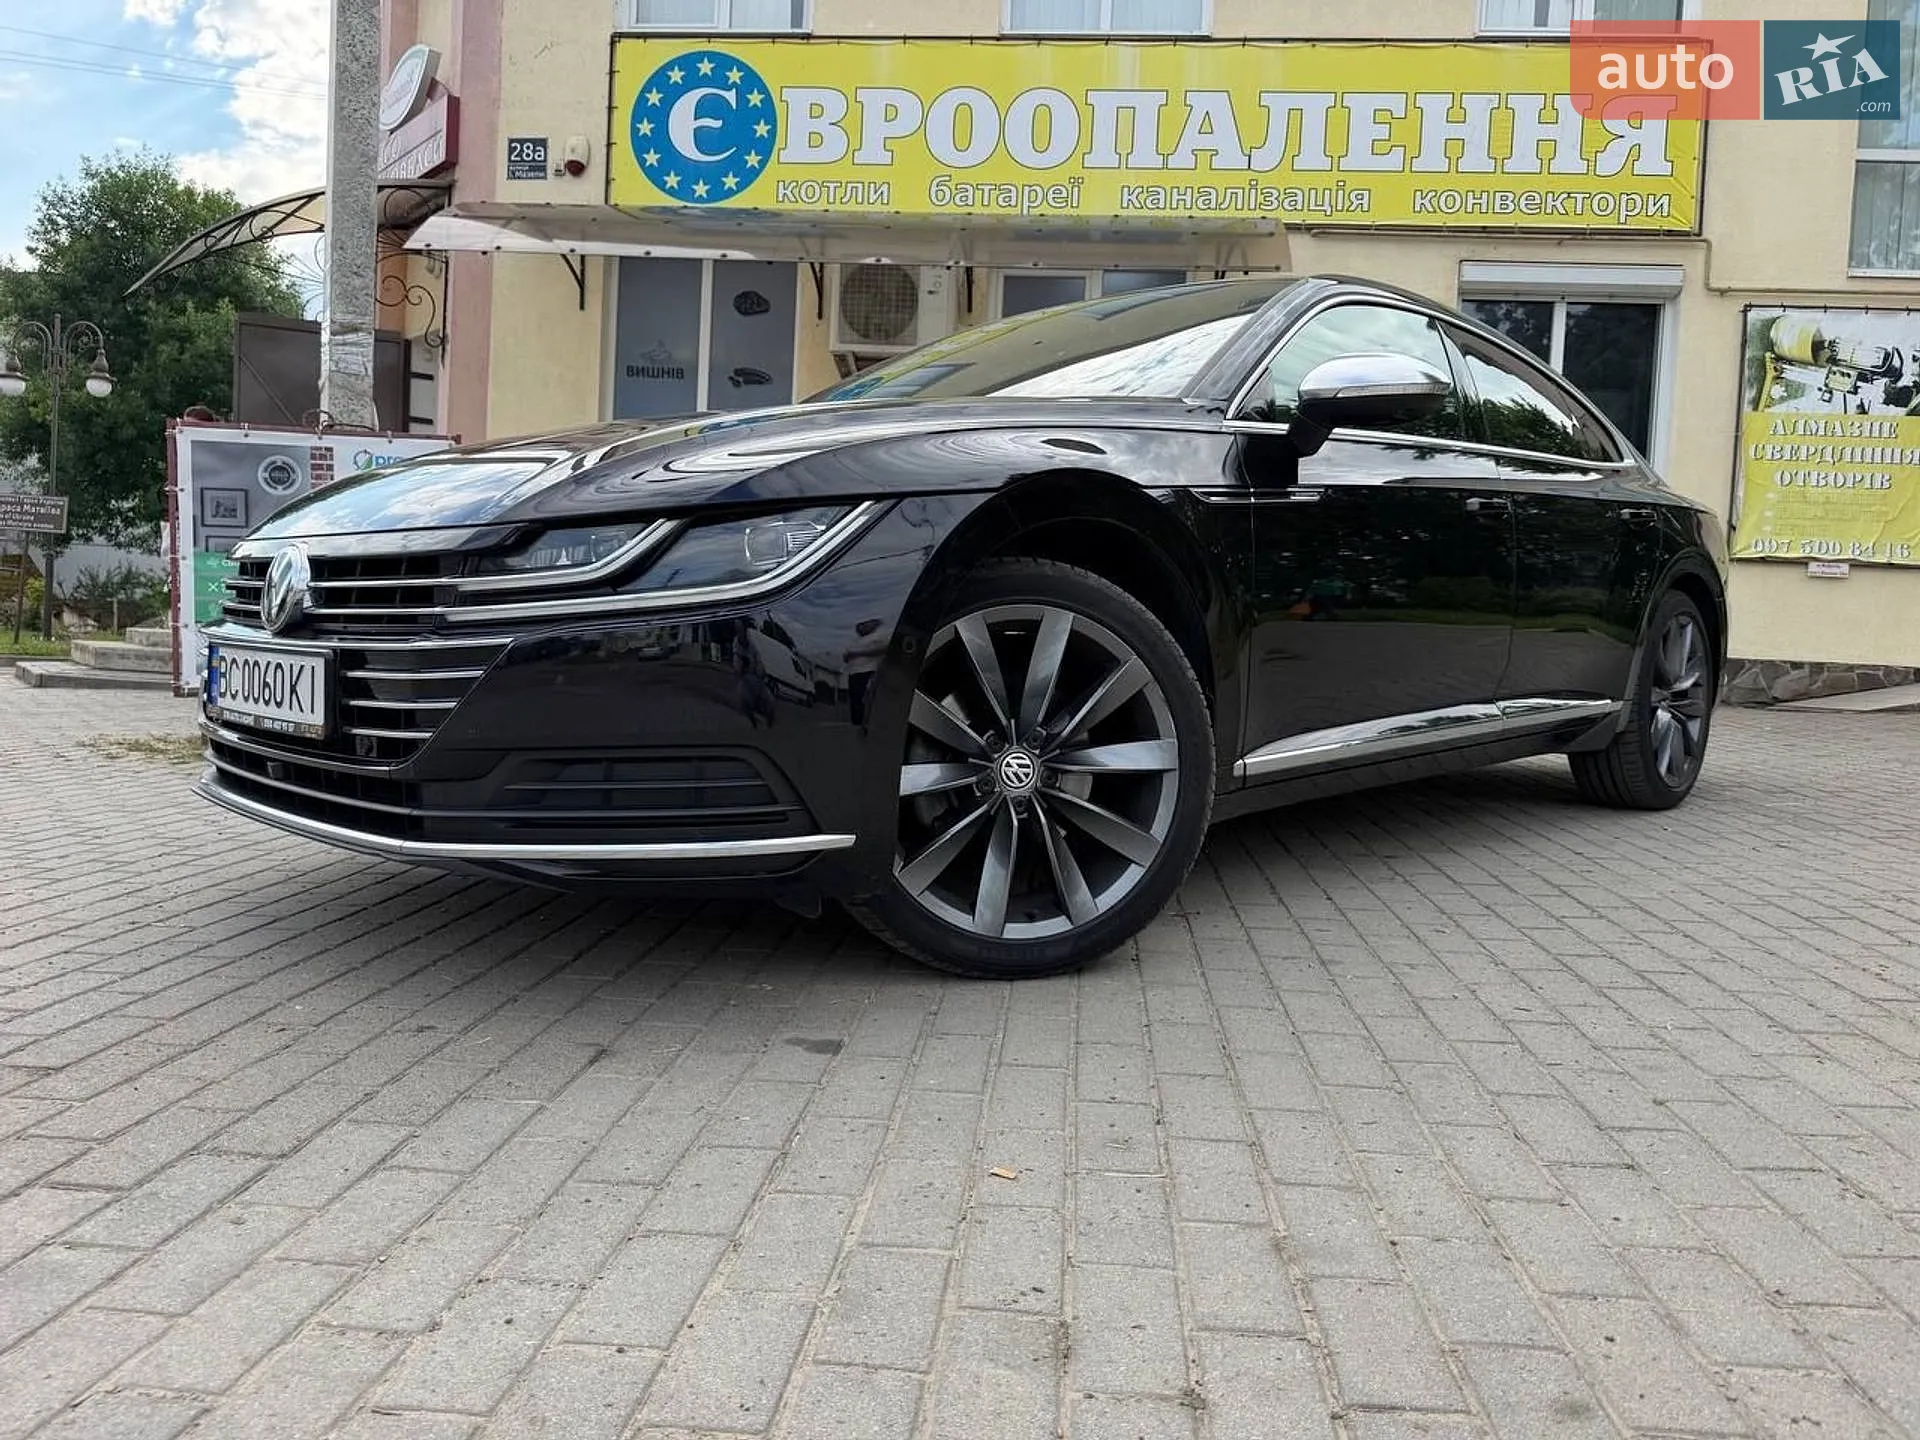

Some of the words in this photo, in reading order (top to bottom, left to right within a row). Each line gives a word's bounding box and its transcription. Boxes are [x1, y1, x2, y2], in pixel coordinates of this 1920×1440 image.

[668, 86, 1677, 176] ЄВРООПАЛЕННЯ
[511, 142, 544, 160] 28а
[776, 179, 891, 205] котли
[928, 174, 1084, 217] батареї
[1120, 178, 1370, 216] каналізація
[1412, 186, 1672, 224] конвектори
[1769, 418, 1899, 439] АЛМАЗНЕ
[1774, 470, 1893, 490] ОТВОРІВ
[1752, 538, 1792, 554] 097
[1800, 539, 1842, 556] 500
